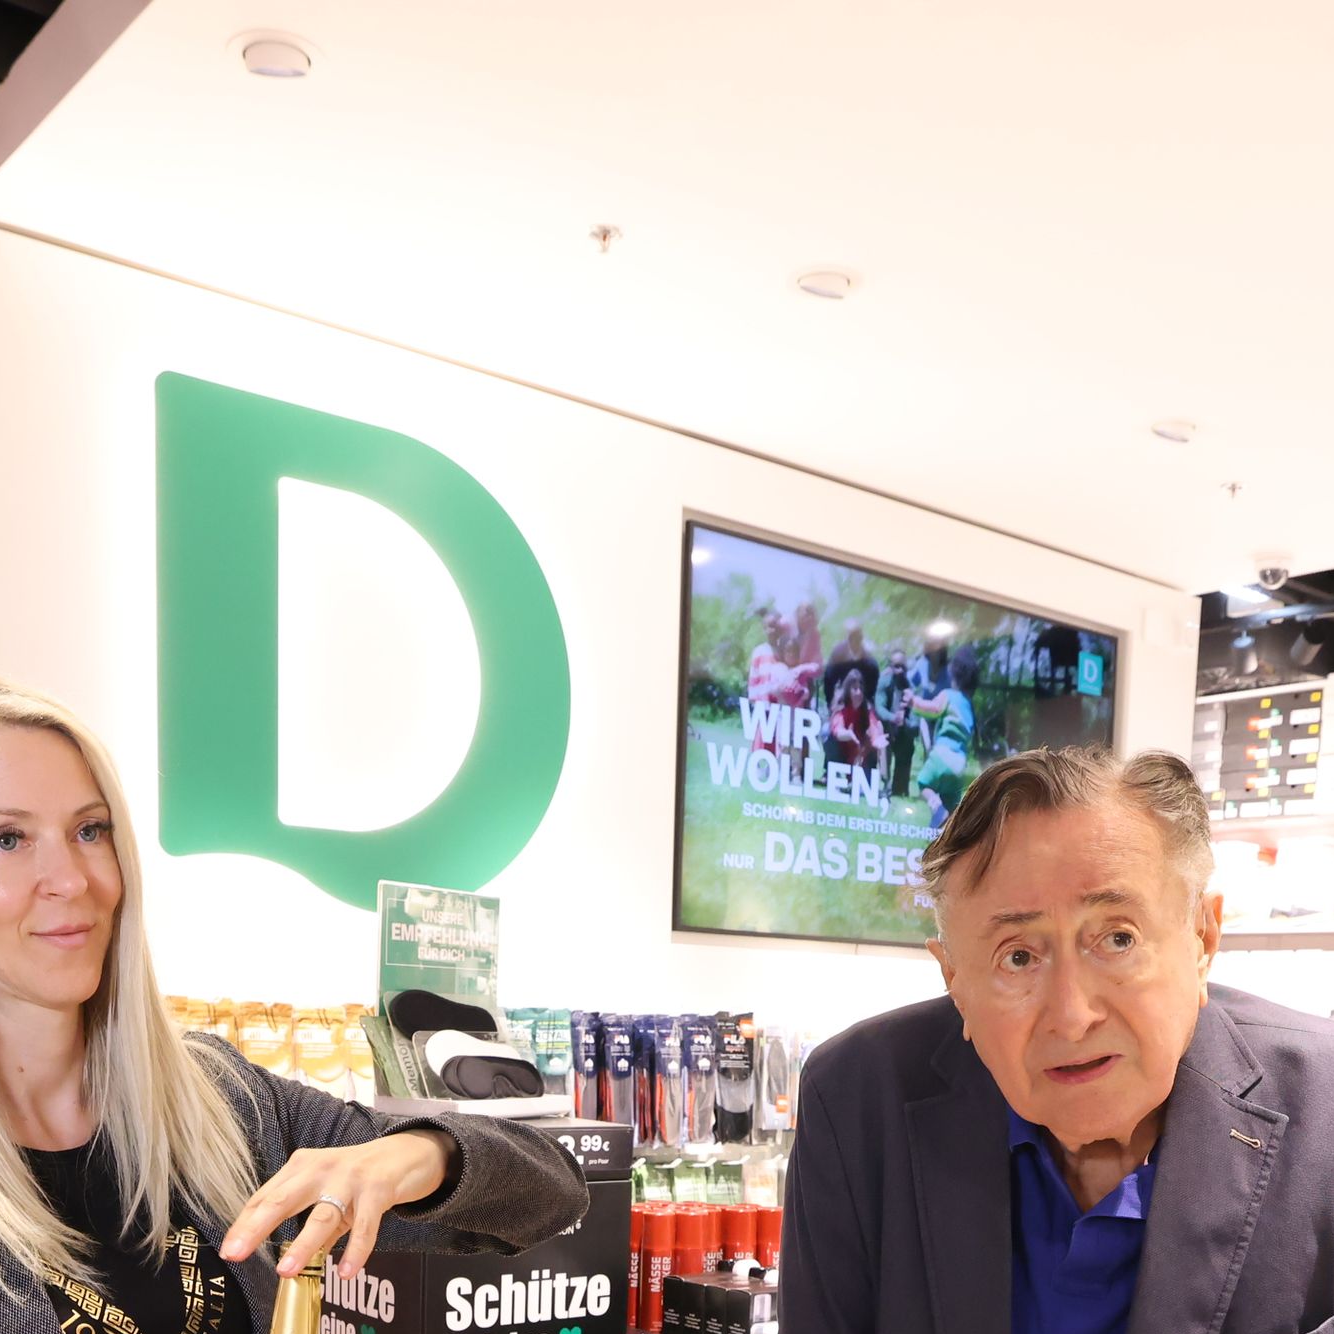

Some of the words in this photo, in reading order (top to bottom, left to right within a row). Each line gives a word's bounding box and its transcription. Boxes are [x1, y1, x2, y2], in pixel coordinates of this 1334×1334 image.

[154, 370, 571, 912] D
[740, 696, 822, 752] WIR
[706, 741, 891, 817] WOLLEN,
[742, 802, 793, 822] SCHON
[796, 807, 815, 825] AB
[817, 813, 846, 829] DEM
[848, 817, 898, 836] ERSTEN
[723, 853, 754, 870] NUR
[763, 831, 849, 880] DAS
[422, 909, 464, 926] UNSERE
[418, 946, 439, 960] FÜR
[440, 948, 465, 962] DICH
[598, 1157, 610, 1165] Paar
[649, 1256, 662, 1293] NÄSSE
[445, 1269, 612, 1332] Schütze
